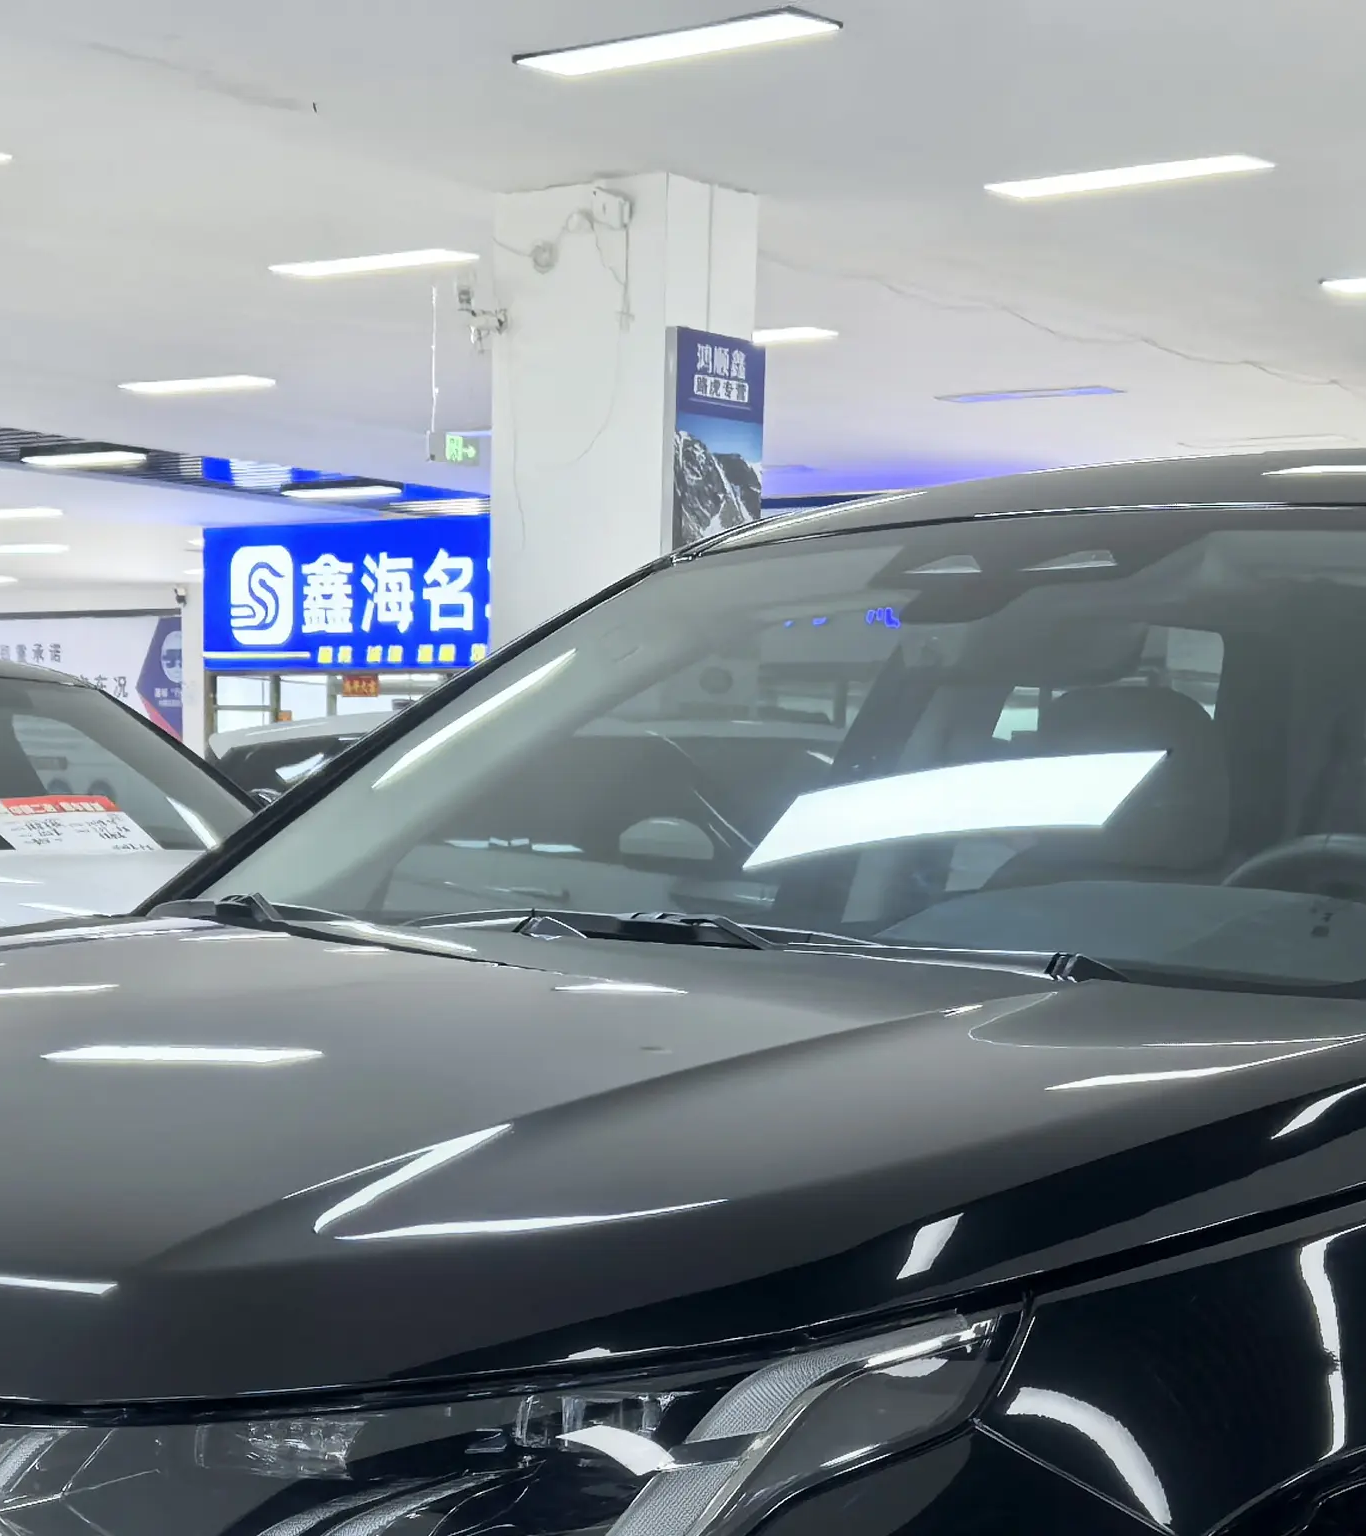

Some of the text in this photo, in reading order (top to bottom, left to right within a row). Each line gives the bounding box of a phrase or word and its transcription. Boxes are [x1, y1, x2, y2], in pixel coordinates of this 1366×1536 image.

[696, 377, 746, 401] 路虎专营
[301, 547, 490, 634] 鑫海名
